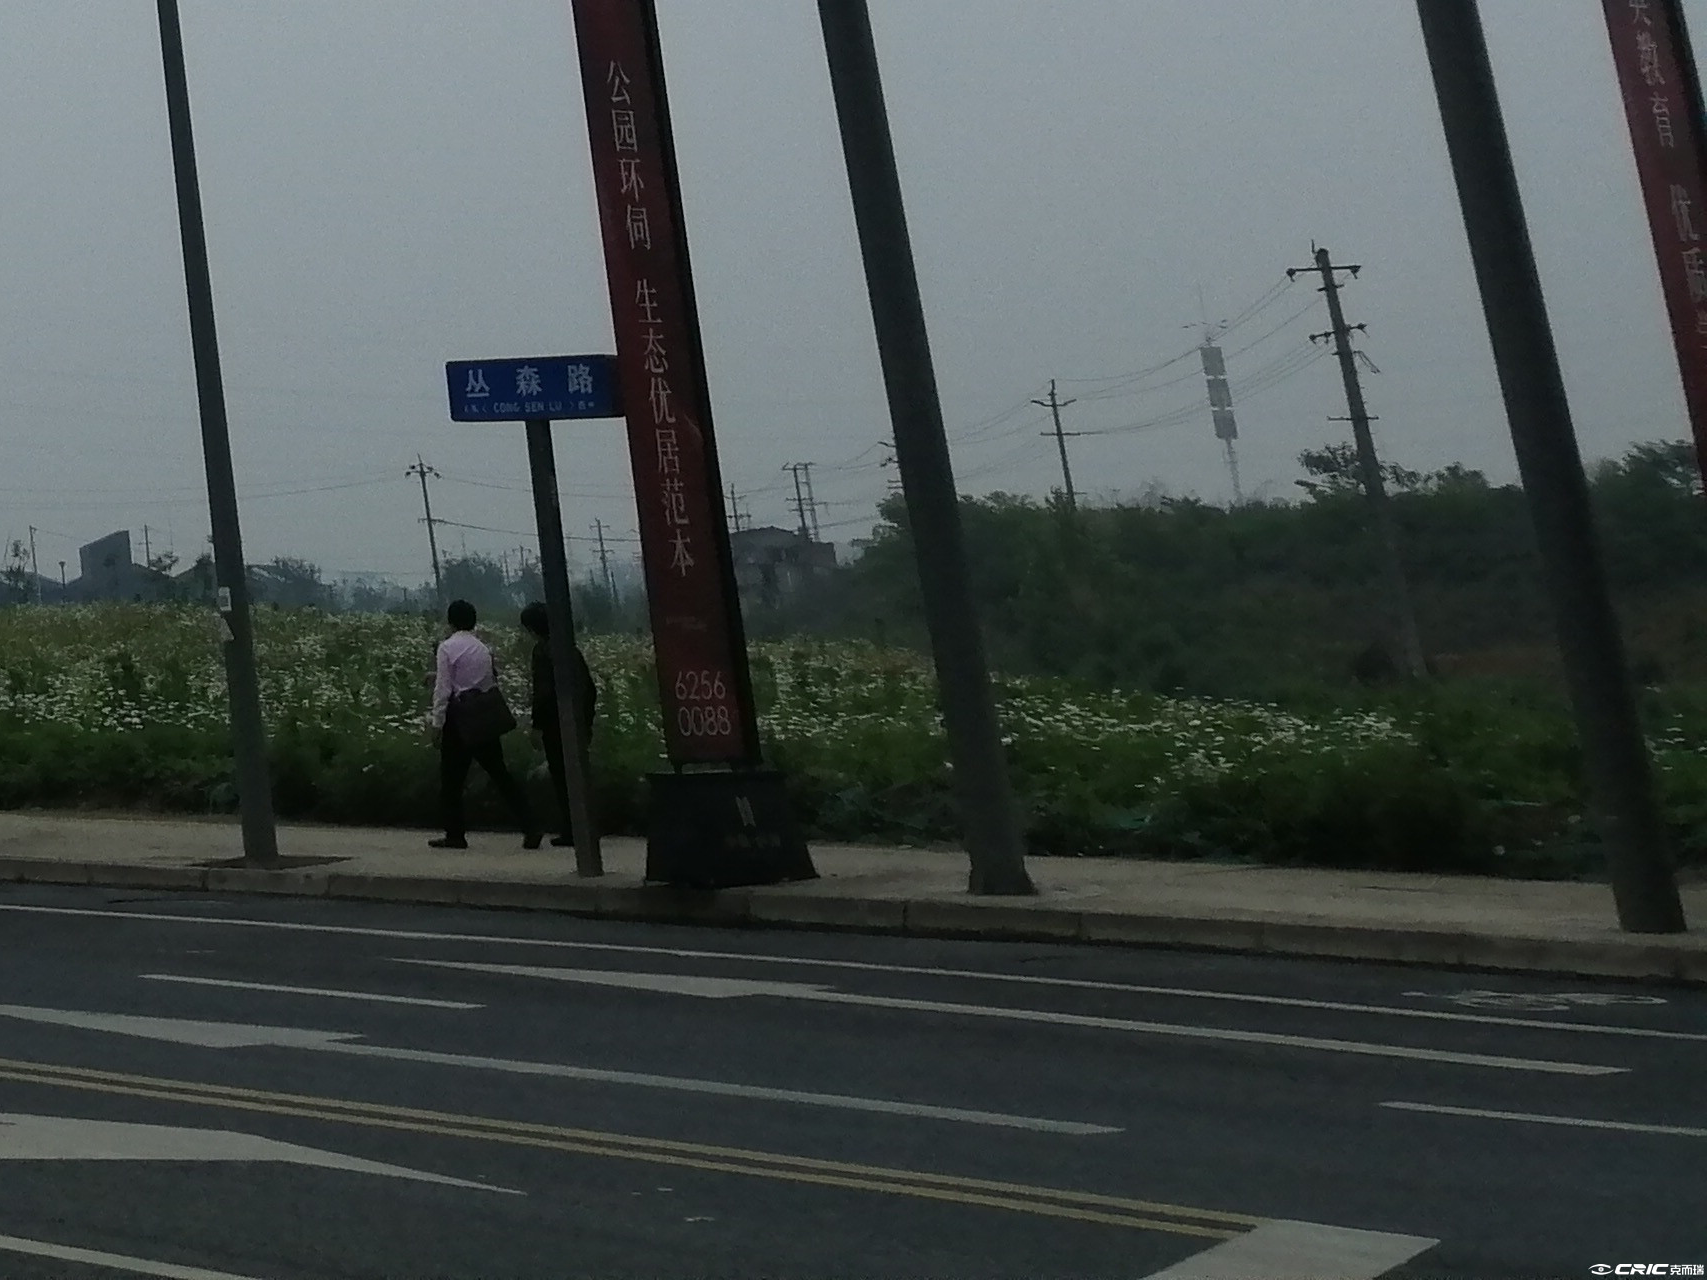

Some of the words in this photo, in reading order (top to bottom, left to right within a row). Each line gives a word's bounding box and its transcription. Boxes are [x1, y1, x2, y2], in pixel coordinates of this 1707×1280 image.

[605, 59, 652, 252] 公园环伺
[634, 278, 694, 580] 生态优居范本
[465, 363, 593, 398] 丛森路
[493, 401, 520, 414] CONG
[524, 401, 545, 413] SEN
[549, 400, 563, 412] LU
[674, 668, 726, 700] 6256
[677, 704, 732, 737] 0088
